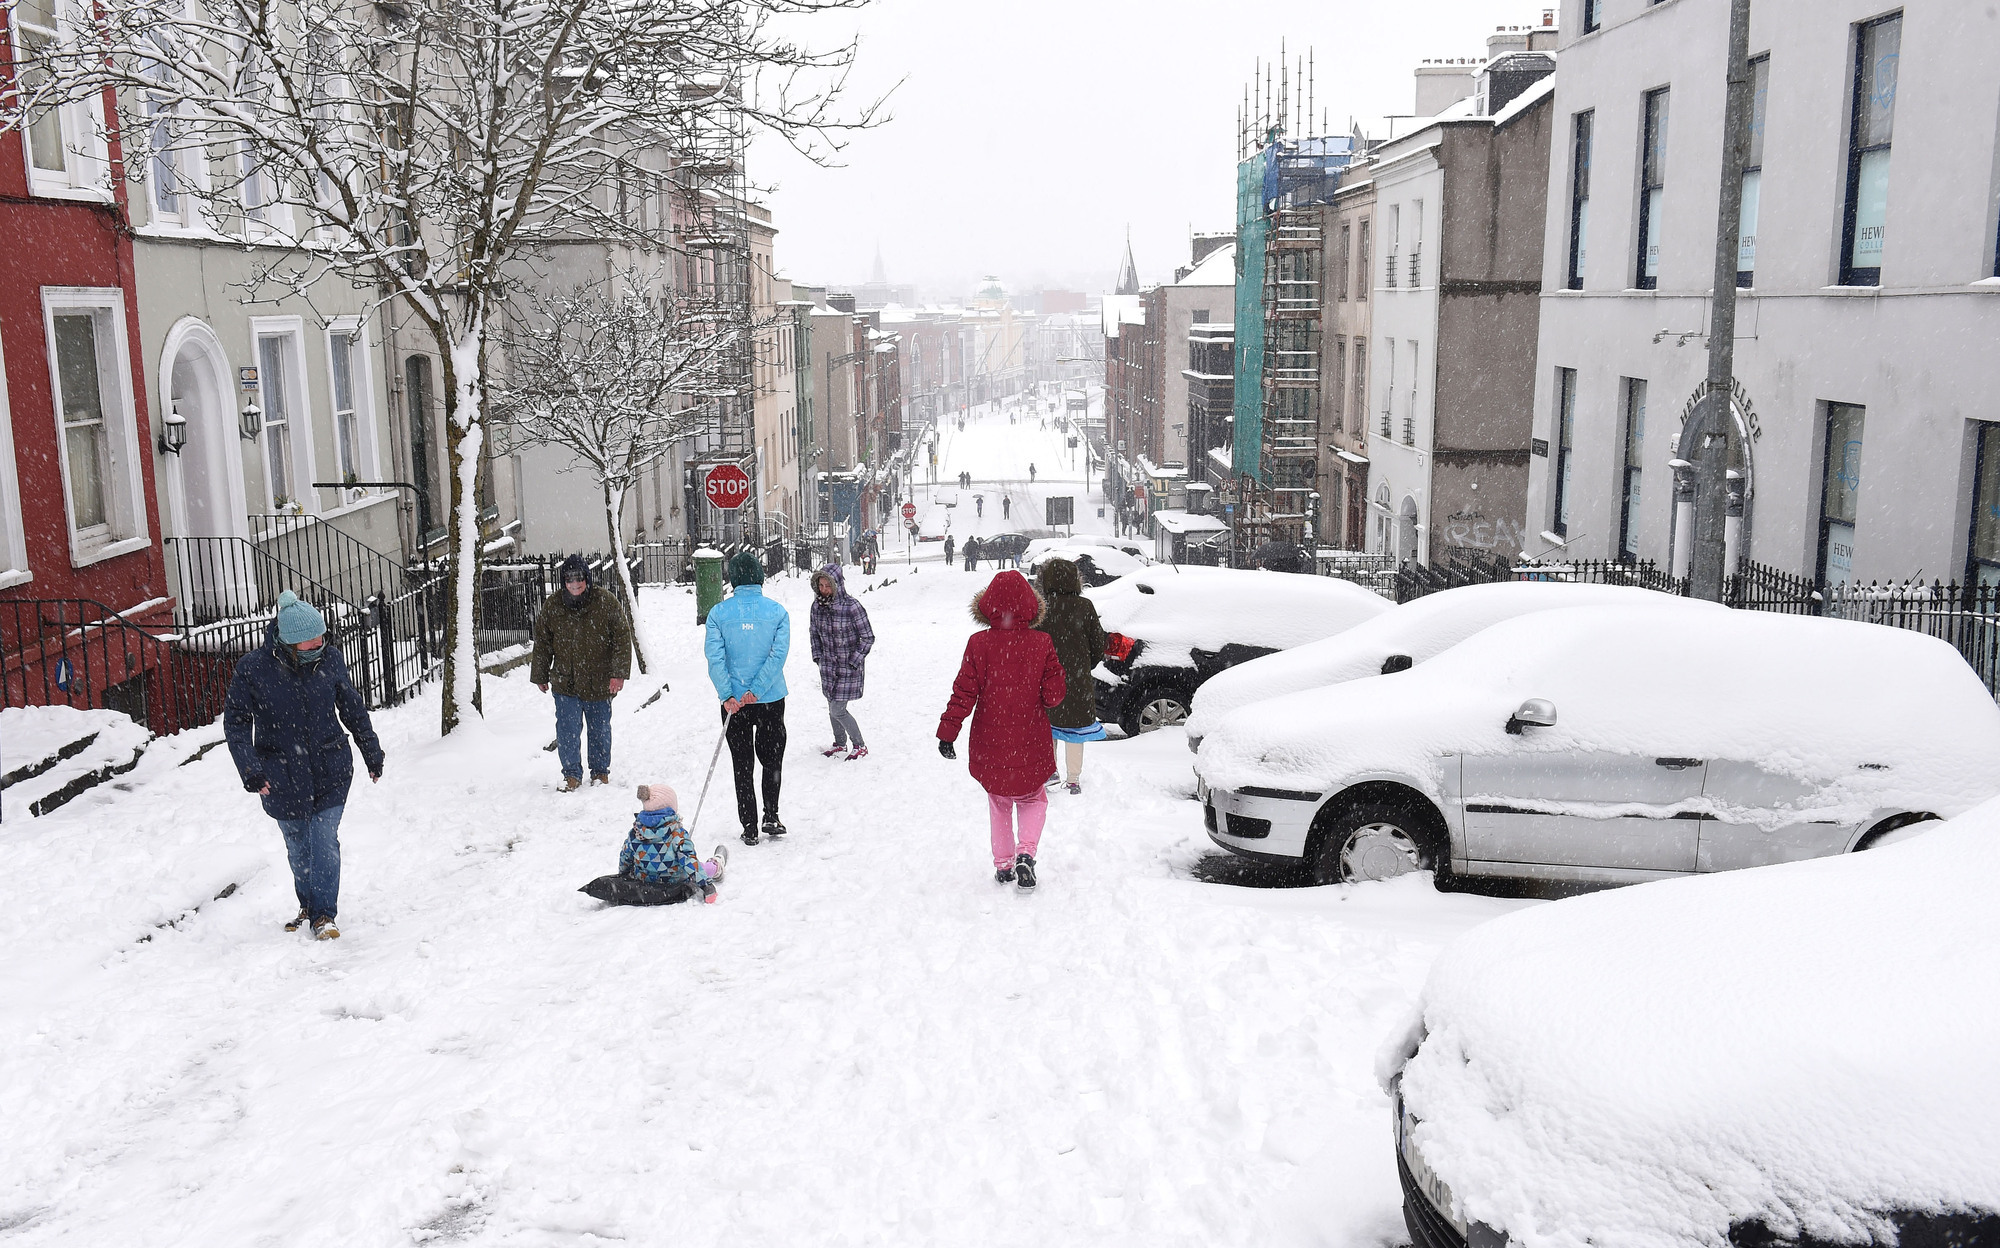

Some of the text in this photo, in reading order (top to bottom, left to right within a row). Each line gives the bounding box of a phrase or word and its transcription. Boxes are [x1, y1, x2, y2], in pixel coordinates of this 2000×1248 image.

[1730, 376, 1762, 444] OLLEGE
[708, 479, 748, 495] STOP
[901, 507, 917, 515] STOP
[742, 623, 754, 631] HH
